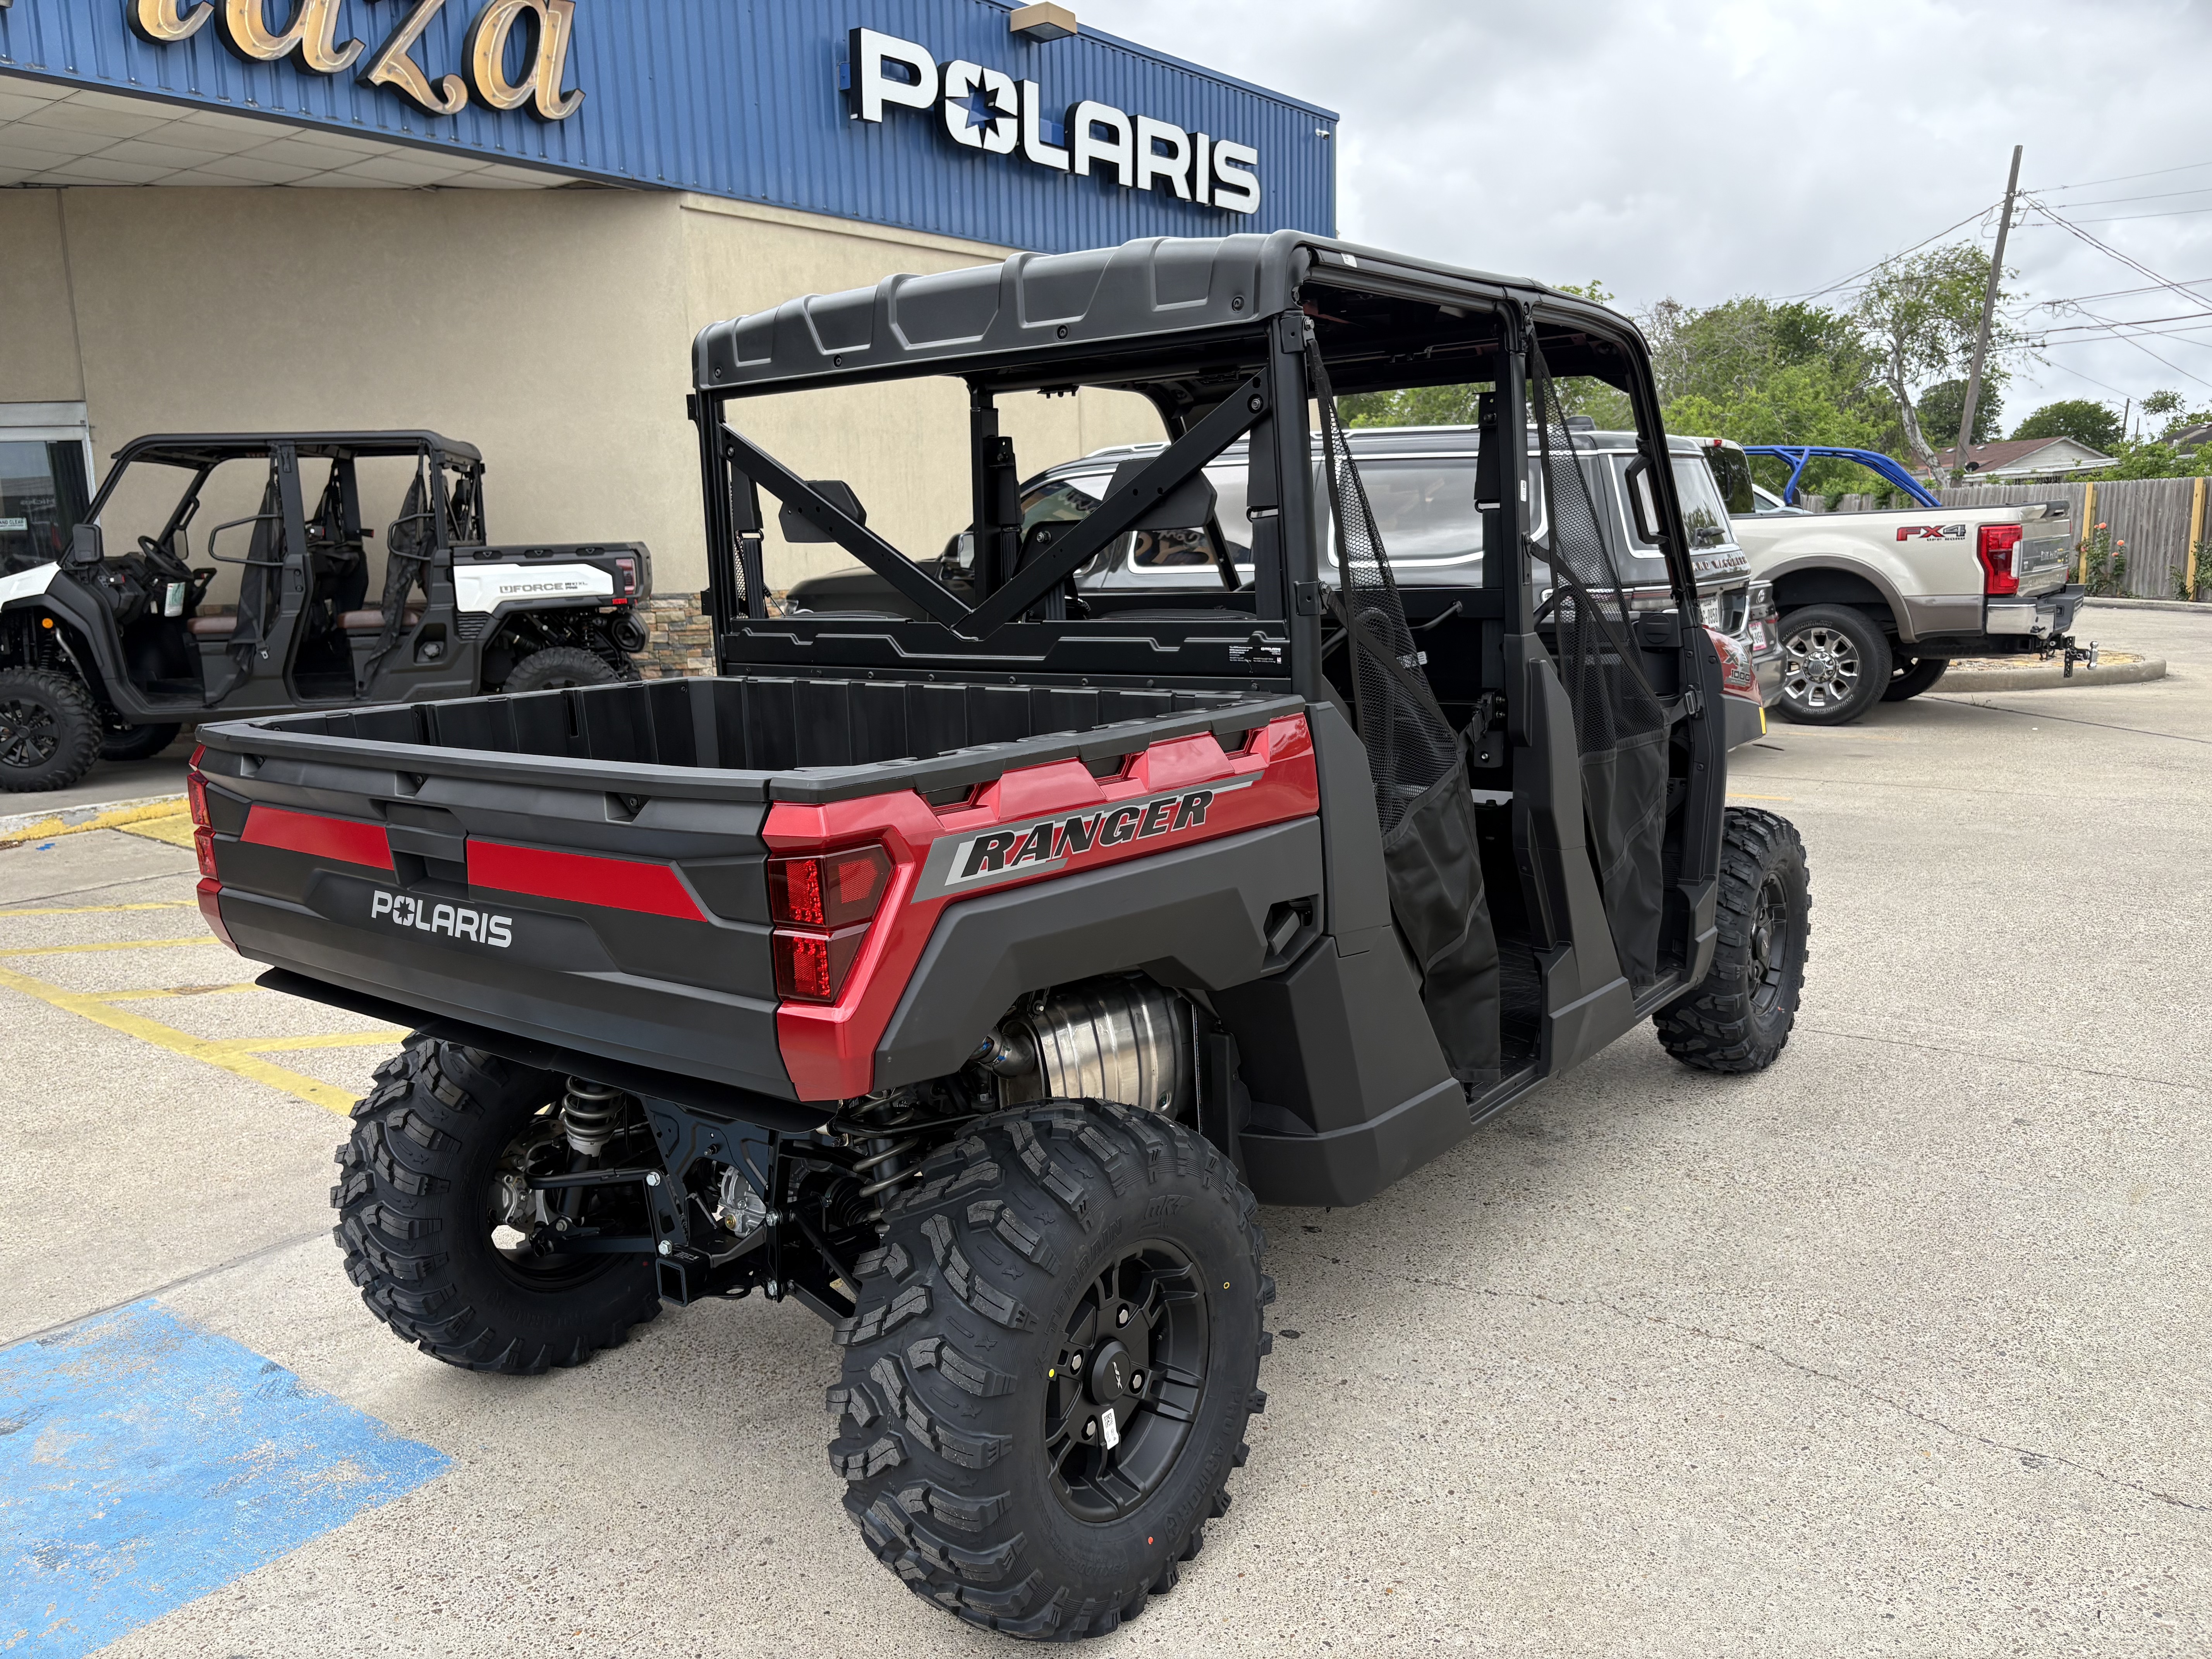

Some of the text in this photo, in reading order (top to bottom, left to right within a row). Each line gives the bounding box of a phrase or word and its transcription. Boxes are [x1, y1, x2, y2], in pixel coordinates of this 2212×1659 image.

[128, 0, 587, 122] aza
[850, 27, 1261, 214] POLARIS
[1896, 524, 1966, 541] FX4
[1692, 560, 1711, 571] AND
[1731, 669, 1750, 682] 1000
[960, 790, 1214, 878] RANGER
[371, 890, 513, 948] POLARIS
